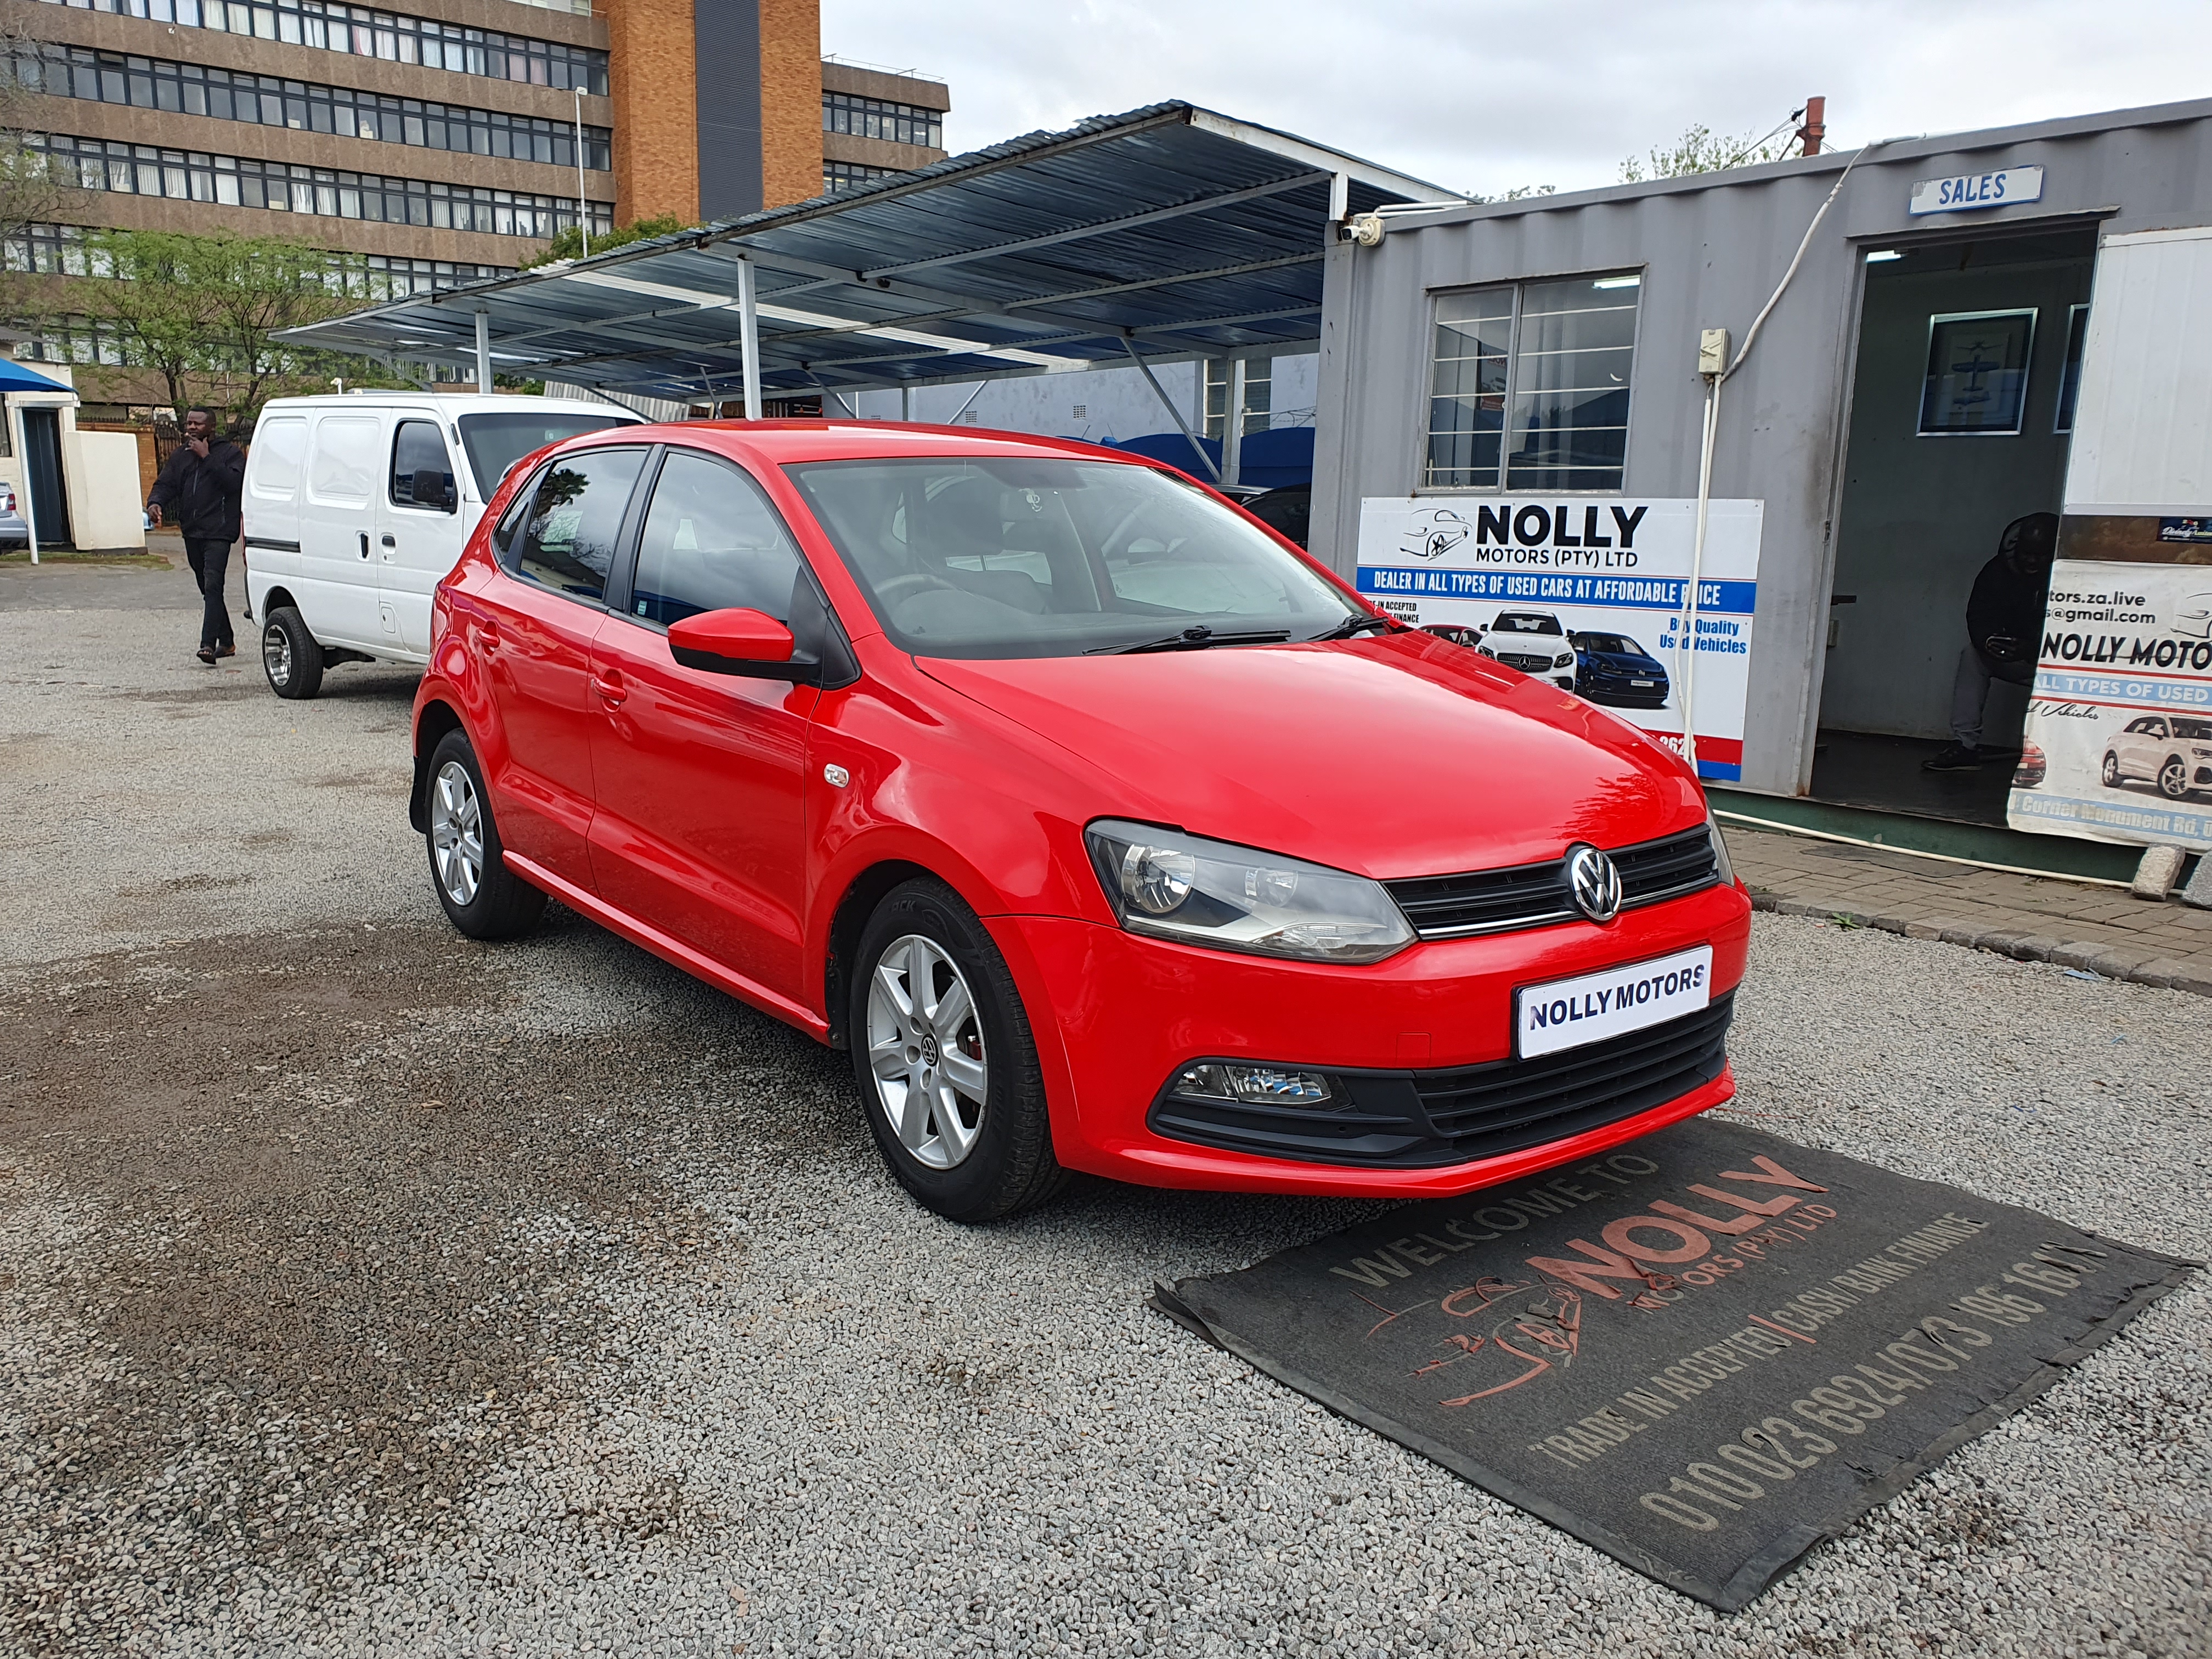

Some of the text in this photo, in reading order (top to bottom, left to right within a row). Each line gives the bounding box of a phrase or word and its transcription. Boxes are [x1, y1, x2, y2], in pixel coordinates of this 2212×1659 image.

[1939, 173, 2006, 205] SALES
[1476, 505, 1649, 548] NOLLY
[1476, 548, 1638, 568] MOTORS (PTY) LTD
[1374, 571, 1721, 605] DEALER IN ALL TYPES OF USED CARS AT AFFORDABLE PICE
[2049, 590, 2146, 606] tors.za.live
[1385, 601, 1417, 611] ACCEPTED
[1394, 613, 1419, 623] FINANCE
[1695, 619, 1739, 636] Quality
[1694, 637, 1746, 654] Vehicles
[2041, 632, 2212, 670] NOLLY MOTO
[2066, 678, 2120, 695] TYPES
[2126, 684, 2153, 697] OF
[2158, 686, 2208, 702] USED
[2022, 796, 2078, 817] Corner
[2081, 803, 2169, 832] Monument
[1530, 964, 1705, 1030] NOLLY MOTORS
[1329, 1154, 1659, 1288] WELCOME TO
[1525, 1154, 1830, 1300] NOLLY
[1784, 1204, 1837, 1231] LTD
[1527, 1404, 1649, 1469] TRADE
[1616, 1386, 1679, 1419] IN
[1885, 1211, 1990, 1265] FINANCE
[1639, 1462, 1766, 1533] 010
[1718, 1417, 1838, 1481] 023
